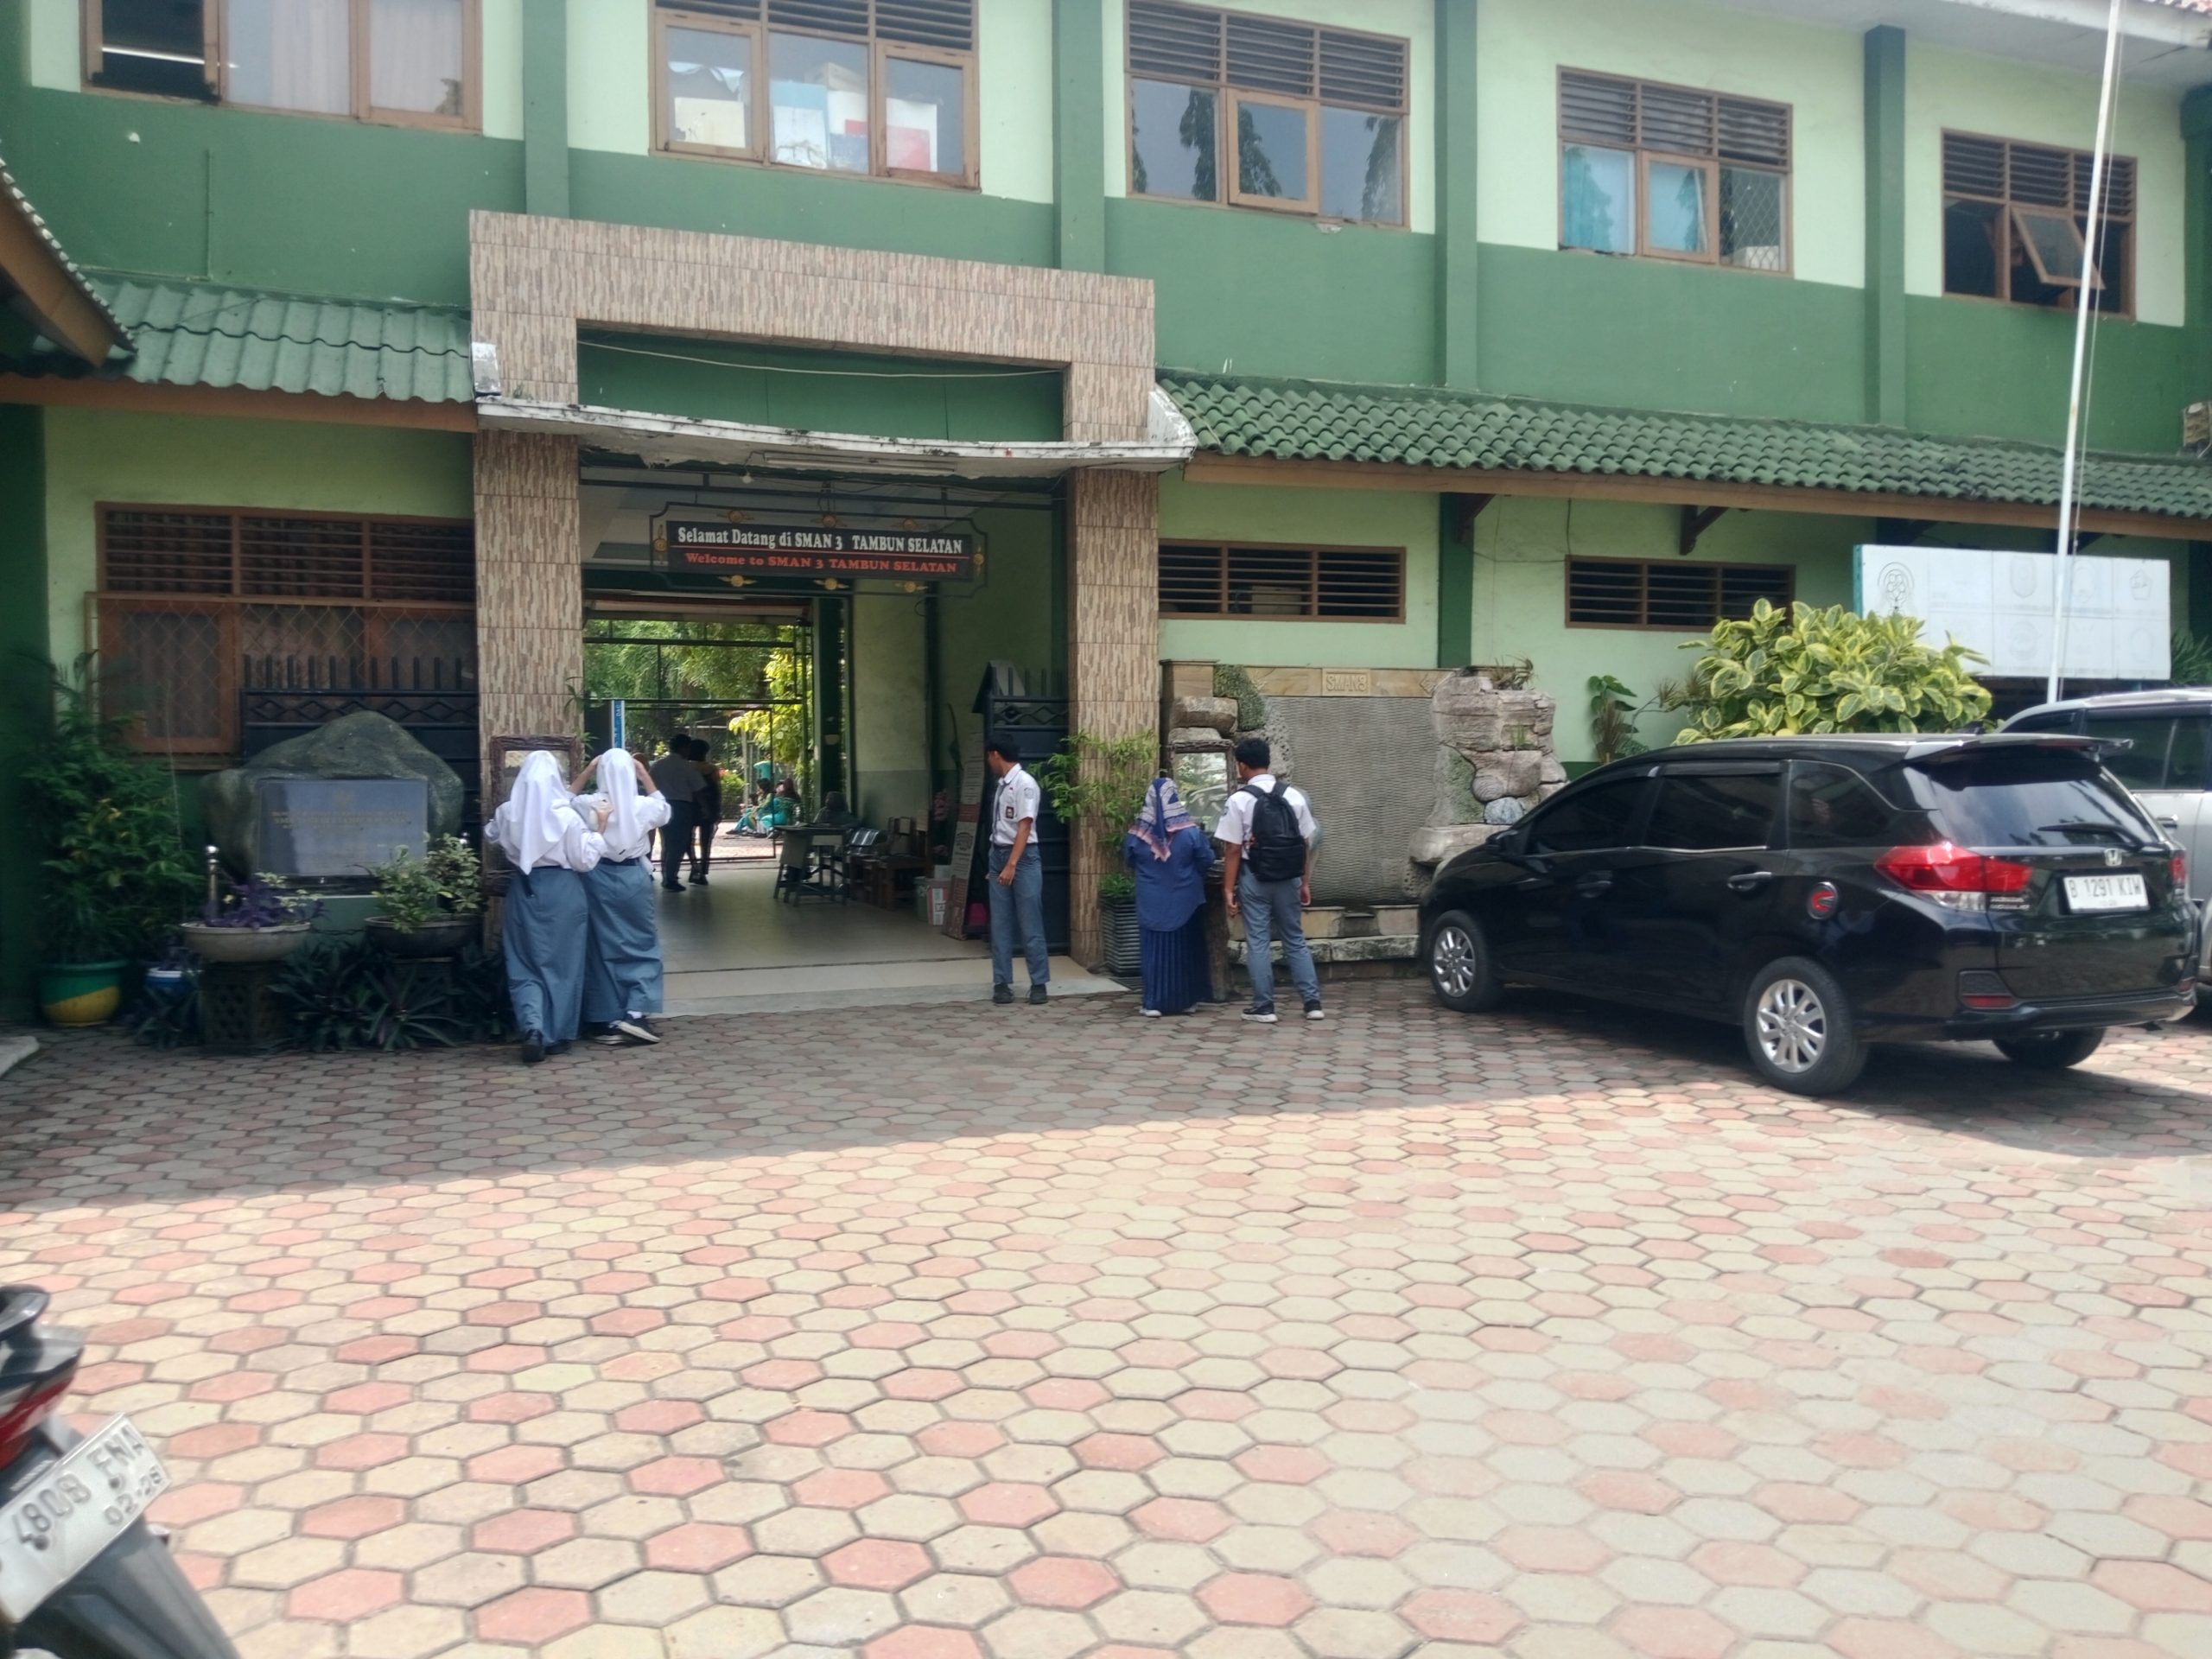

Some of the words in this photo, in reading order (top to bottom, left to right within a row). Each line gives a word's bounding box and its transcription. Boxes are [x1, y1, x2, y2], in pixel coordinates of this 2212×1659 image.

[678, 527, 728, 543] Selamat
[732, 529, 776, 550] Datang
[779, 531, 791, 546] di
[795, 532, 832, 548] SMAN
[835, 536, 842, 550] 3
[852, 535, 905, 552] TAMBUN
[908, 537, 962, 554] SELATAN
[685, 552, 746, 565] Welcome
[749, 556, 764, 566] to
[767, 556, 811, 568] SMAN
[816, 559, 823, 569] 3
[829, 558, 890, 570] TAMBUN
[893, 561, 957, 572] SELATAN
